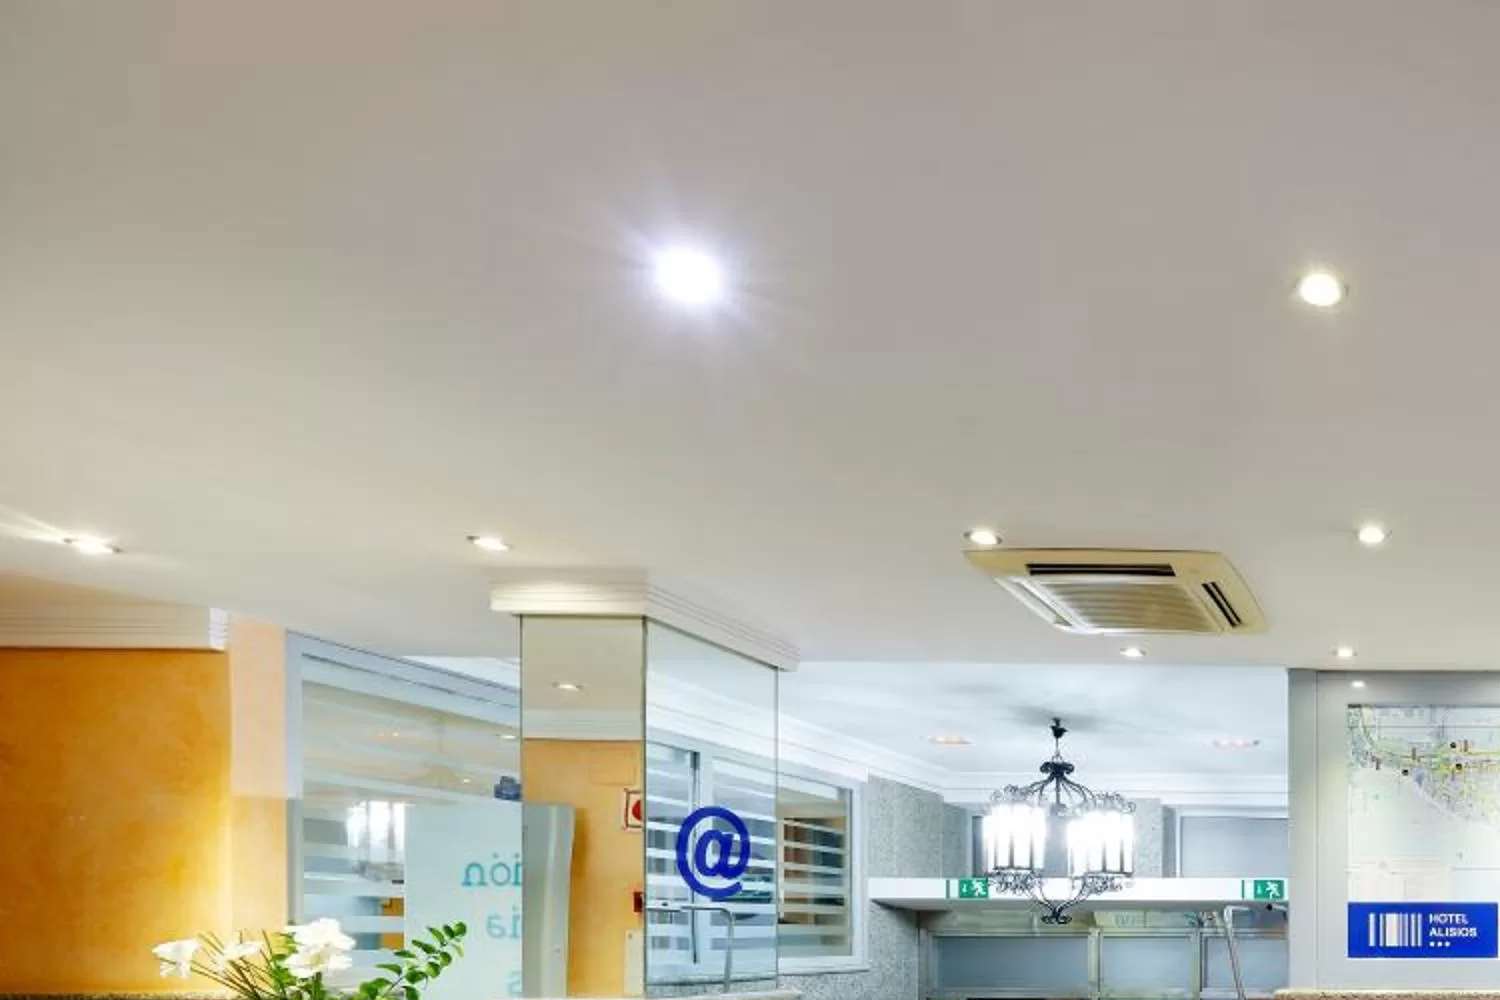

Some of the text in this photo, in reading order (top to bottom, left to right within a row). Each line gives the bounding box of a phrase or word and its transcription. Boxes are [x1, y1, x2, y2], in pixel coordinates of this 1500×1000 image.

[676, 806, 750, 902] @
[1429, 913, 1469, 924] HOTEL
[1429, 927, 1477, 938] ALISIOS
